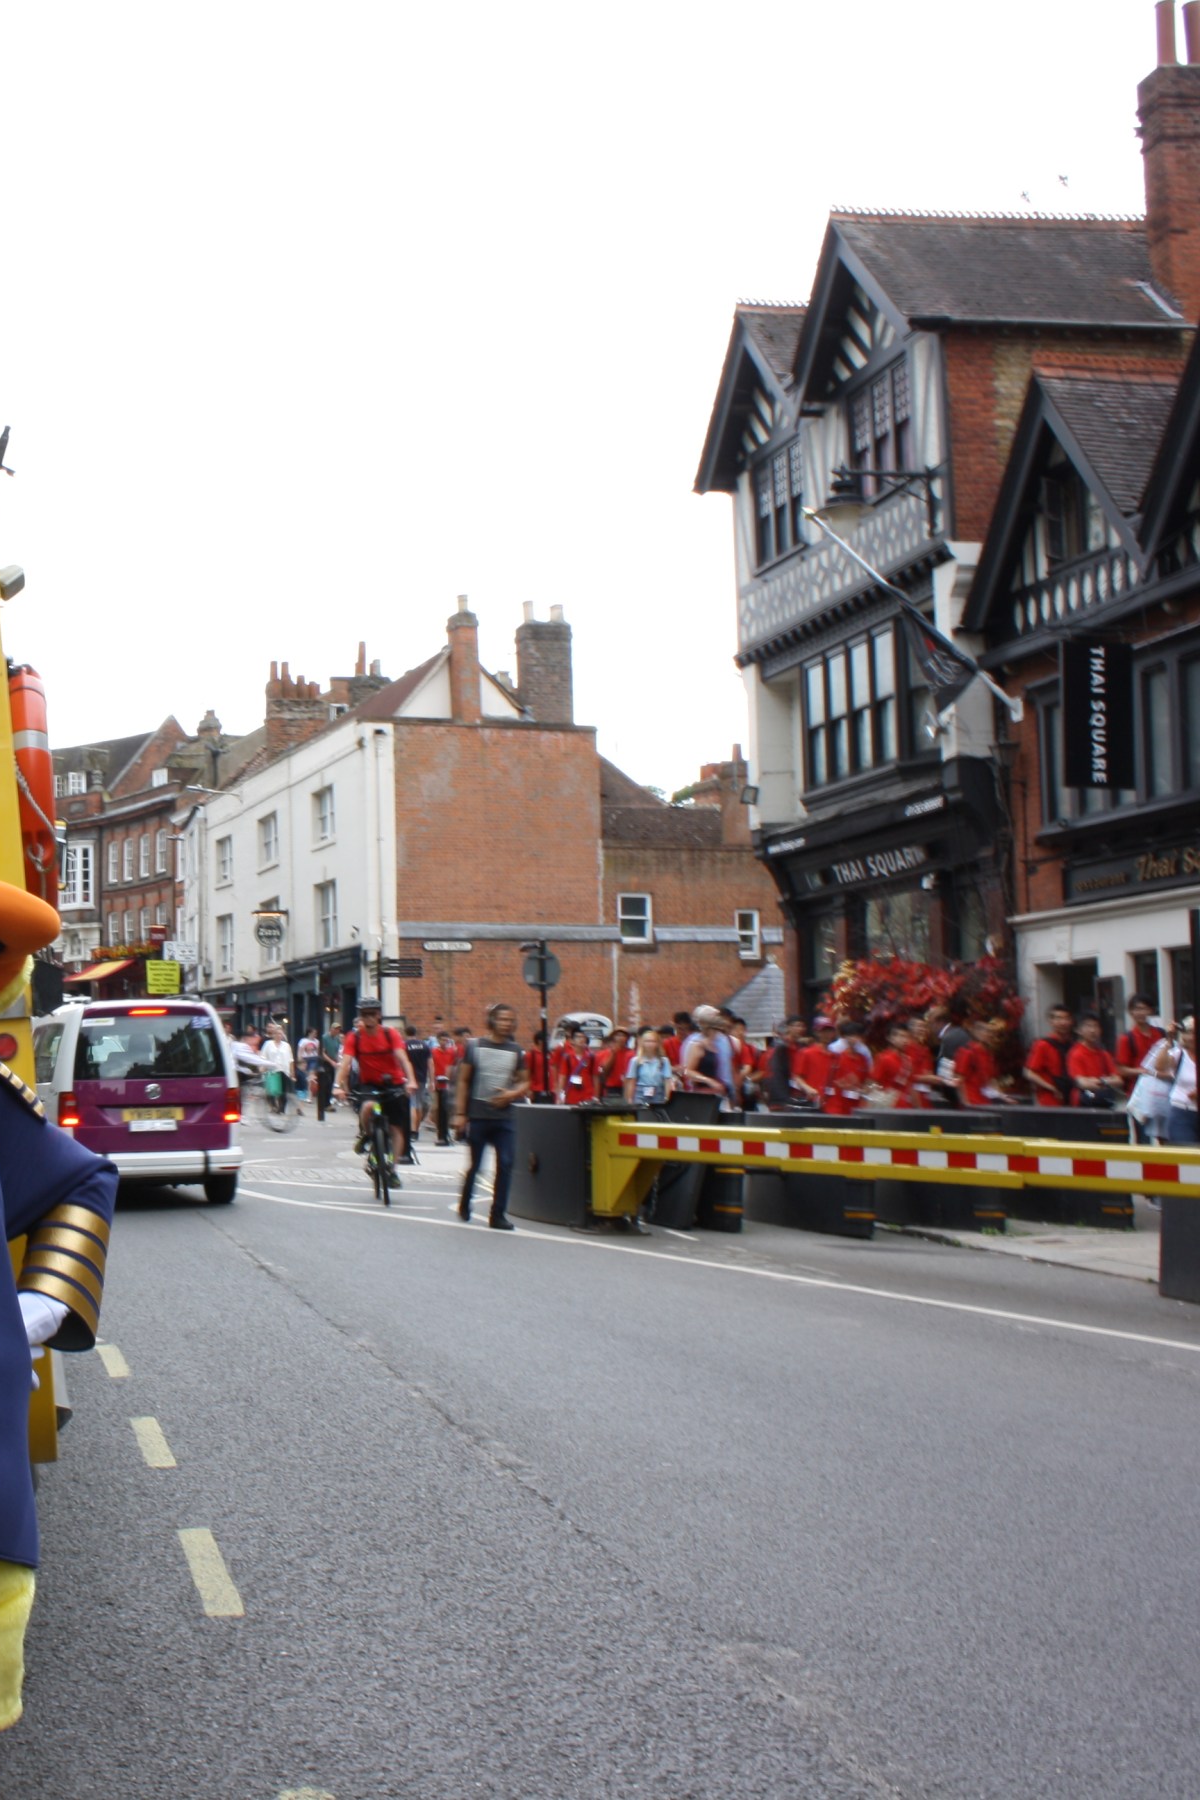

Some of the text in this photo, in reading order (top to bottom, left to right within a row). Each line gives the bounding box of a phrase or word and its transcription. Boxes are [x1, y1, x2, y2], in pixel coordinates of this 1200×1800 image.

[1089, 646, 1108, 784] THAI SQUARE
[832, 859, 865, 884] THAI
